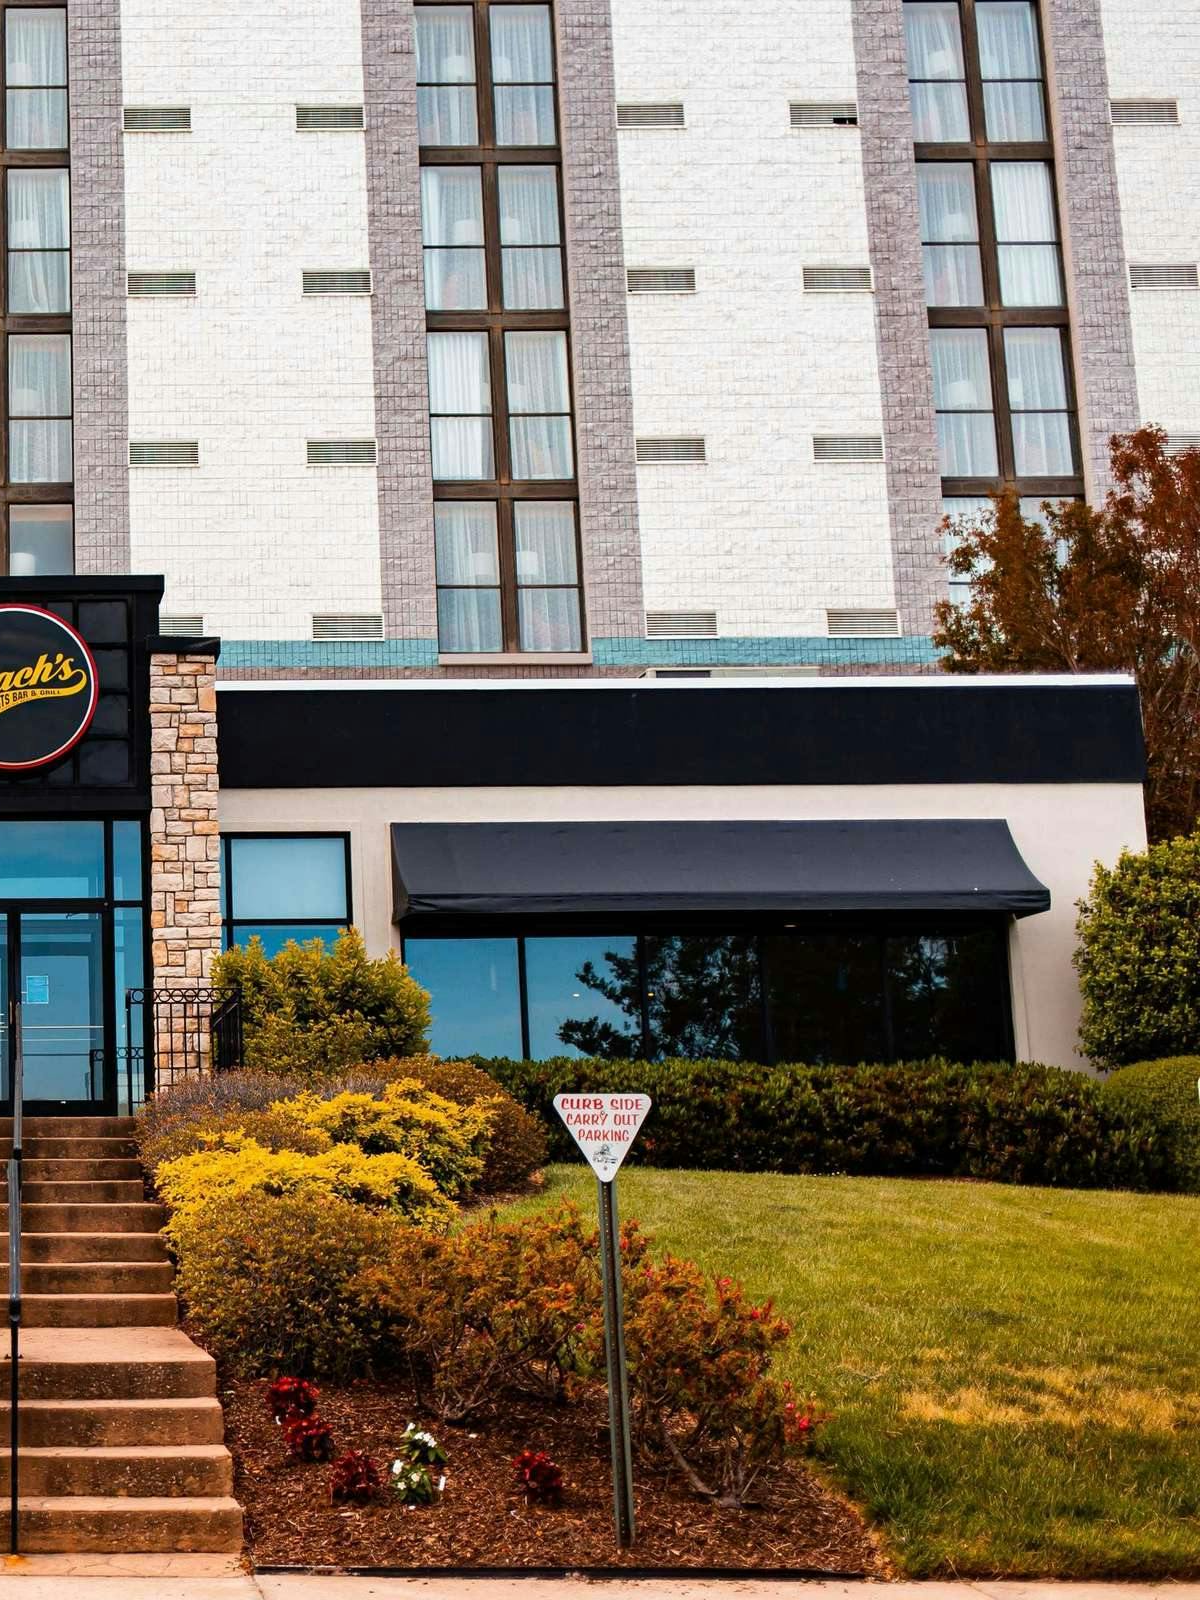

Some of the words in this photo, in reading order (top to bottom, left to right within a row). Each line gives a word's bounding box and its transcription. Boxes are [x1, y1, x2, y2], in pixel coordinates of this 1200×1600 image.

[12, 690, 28, 702] BAR
[561, 1098, 604, 1110] CURB
[610, 1099, 643, 1110] SIDE
[566, 1113, 608, 1126] CARRY
[613, 1114, 640, 1126] OUT
[578, 1129, 630, 1142] PARKING
